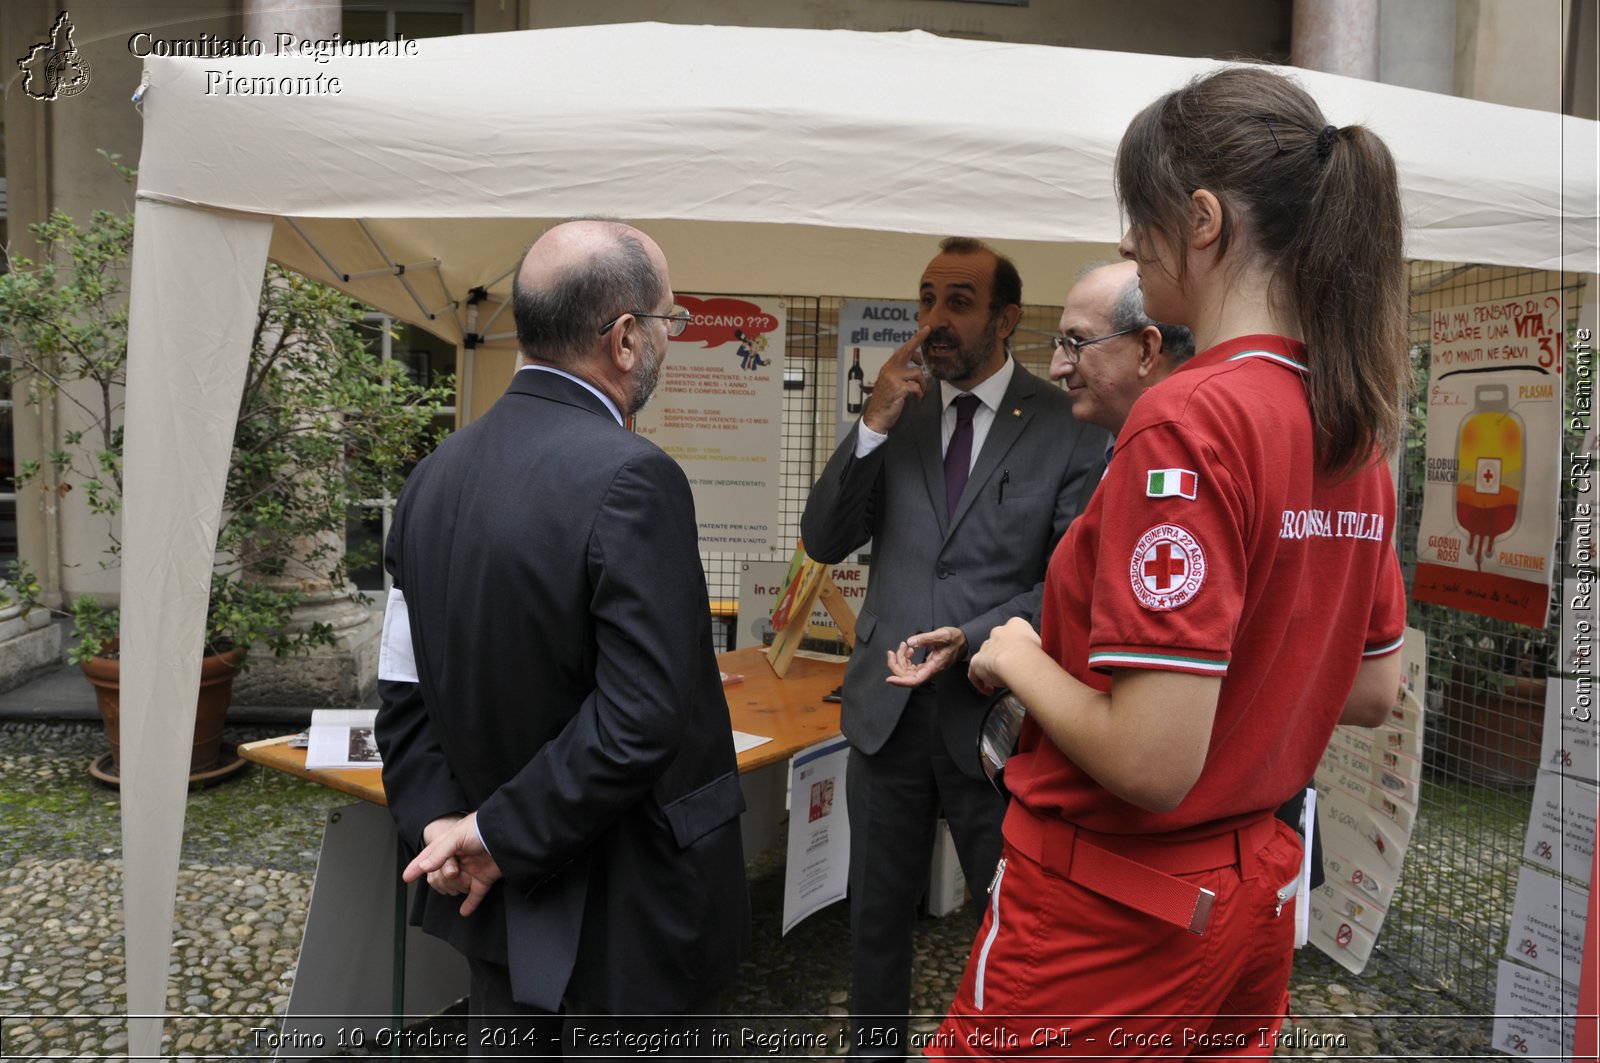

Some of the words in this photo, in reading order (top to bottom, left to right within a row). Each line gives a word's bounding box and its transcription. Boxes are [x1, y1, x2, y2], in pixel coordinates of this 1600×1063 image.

[862, 306, 910, 322] ALCOL
[1433, 311, 1448, 332] HAI
[1454, 311, 1469, 327] MAI
[1473, 302, 1524, 323] PENSATO
[1526, 300, 1539, 314] DI
[747, 316, 770, 328] ???
[850, 327, 869, 344] gli
[1433, 327, 1482, 345] SALVARE
[1487, 324, 1509, 339] UNA
[1442, 350, 1452, 364] 10
[1456, 348, 1483, 363] MINUTI
[1487, 348, 1500, 360] NE
[1502, 345, 1528, 360] SALVI
[666, 372, 711, 380] SOSPENSIONE
[694, 388, 726, 396] CONFISCA
[1519, 385, 1553, 399] PLASMA
[664, 415, 709, 423] SOSPENSIONE
[696, 422, 713, 430] FINO
[1427, 457, 1460, 471] GLOBULI
[714, 479, 766, 487] (NEOPATENTATI)
[1427, 470, 1459, 483] BIANCHI
[1144, 526, 1179, 544] GINEVRA
[1180, 535, 1193, 548] 22
[1139, 541, 1146, 551] DI
[1428, 535, 1461, 550] GLOBULI
[1437, 549, 1459, 563] ROSSI
[1500, 552, 1545, 571] PIASTRINE
[831, 569, 861, 581] FARE
[1187, 547, 1203, 592] AGOSTO
[1131, 551, 1156, 606] CONVENZIONE
[754, 584, 765, 595] in
[1168, 590, 1189, 606] 1864
